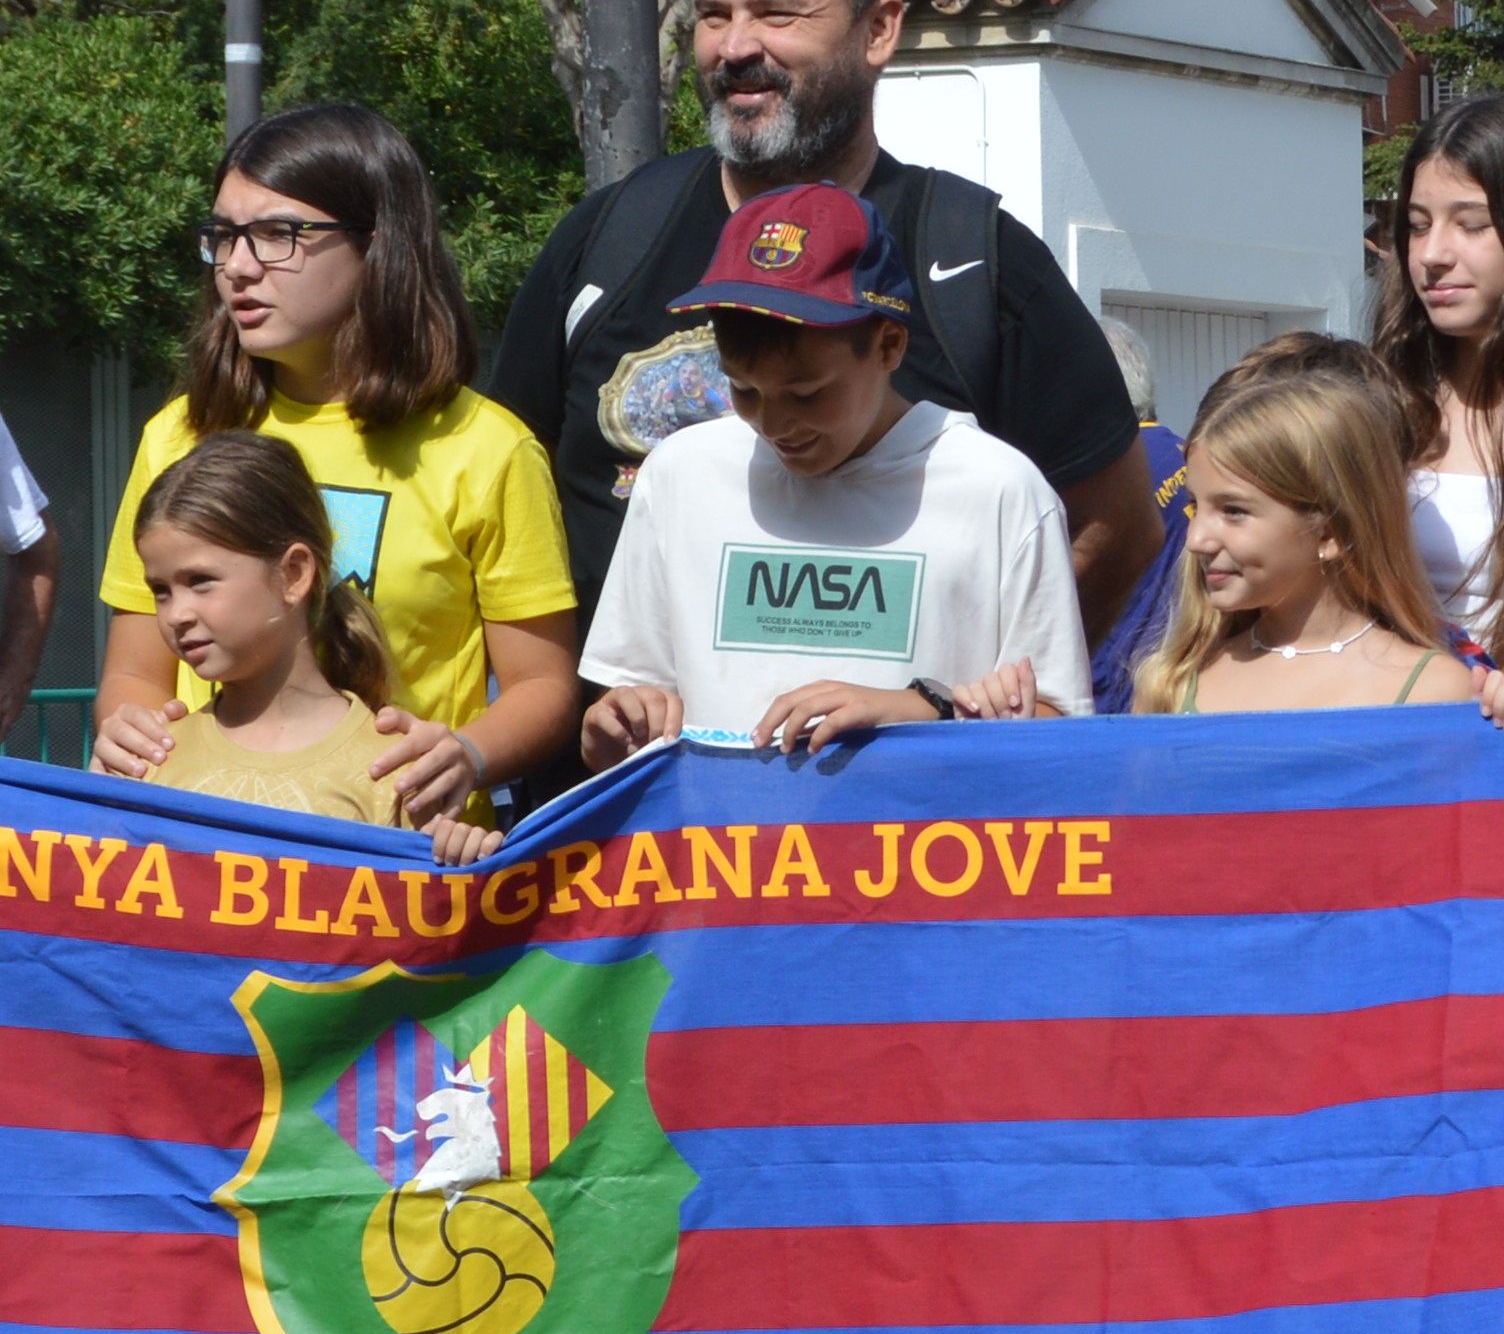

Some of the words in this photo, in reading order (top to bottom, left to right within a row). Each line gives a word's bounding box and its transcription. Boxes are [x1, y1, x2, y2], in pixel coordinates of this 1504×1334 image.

[746, 560, 887, 613] NASA
[756, 615, 792, 626] SUCCESS
[793, 618, 824, 628] ALWAYS
[825, 620, 860, 629] BELONGS
[860, 621, 872, 629] TO
[761, 625, 787, 635] THOSE
[788, 626, 807, 636] WHO
[833, 629, 850, 637] GIVE
[850, 629, 863, 638] UP
[210, 824, 832, 938] BLAUGRANA
[854, 820, 1113, 899] JOVE
